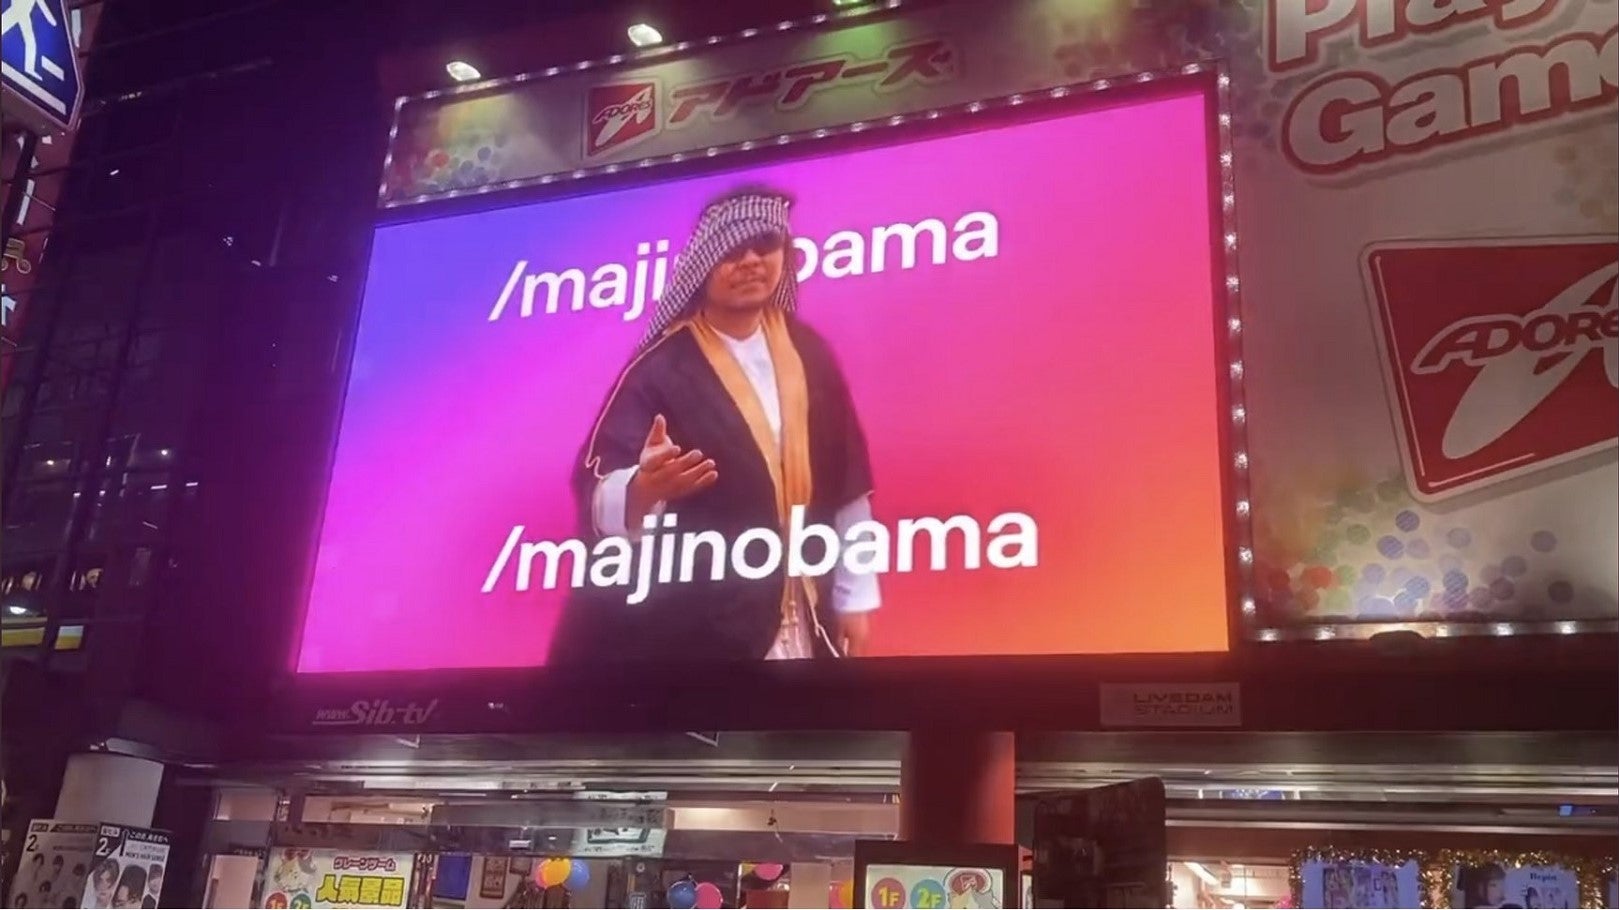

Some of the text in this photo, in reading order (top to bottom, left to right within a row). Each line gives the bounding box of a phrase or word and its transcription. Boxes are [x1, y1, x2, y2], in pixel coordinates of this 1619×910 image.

[1270, 0, 1553, 67] Pl
[667, 38, 955, 125] アドアーズ
[481, 504, 1038, 605] /majinobama
[333, 856, 397, 872] クレーンゲーム
[315, 873, 405, 907] 人気景品
[878, 886, 942, 908] 1F 2F
